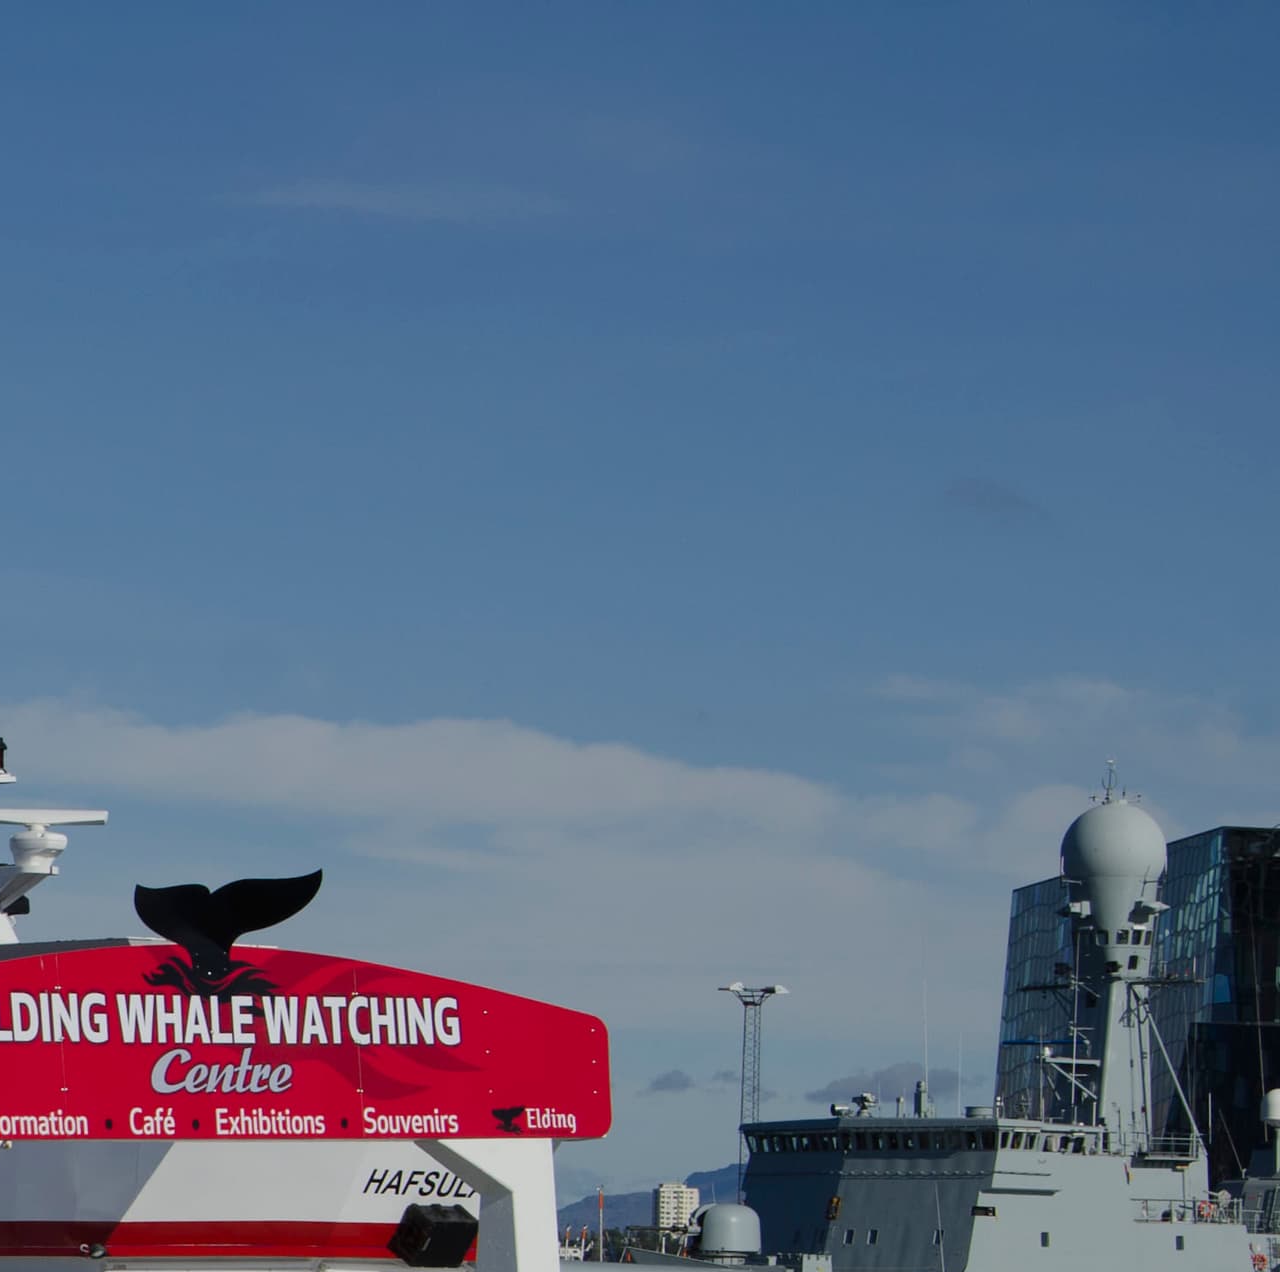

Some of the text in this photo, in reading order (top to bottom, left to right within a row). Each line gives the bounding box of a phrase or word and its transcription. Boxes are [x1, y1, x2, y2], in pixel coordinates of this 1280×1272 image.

[116, 993, 256, 1045] WHALE
[261, 995, 461, 1046] WATCHING
[151, 1047, 293, 1094] Centre
[129, 1106, 176, 1136] Café
[215, 1107, 326, 1136] Exhibitions
[363, 1106, 459, 1135] Souvenirs
[525, 1107, 577, 1134] Elding
